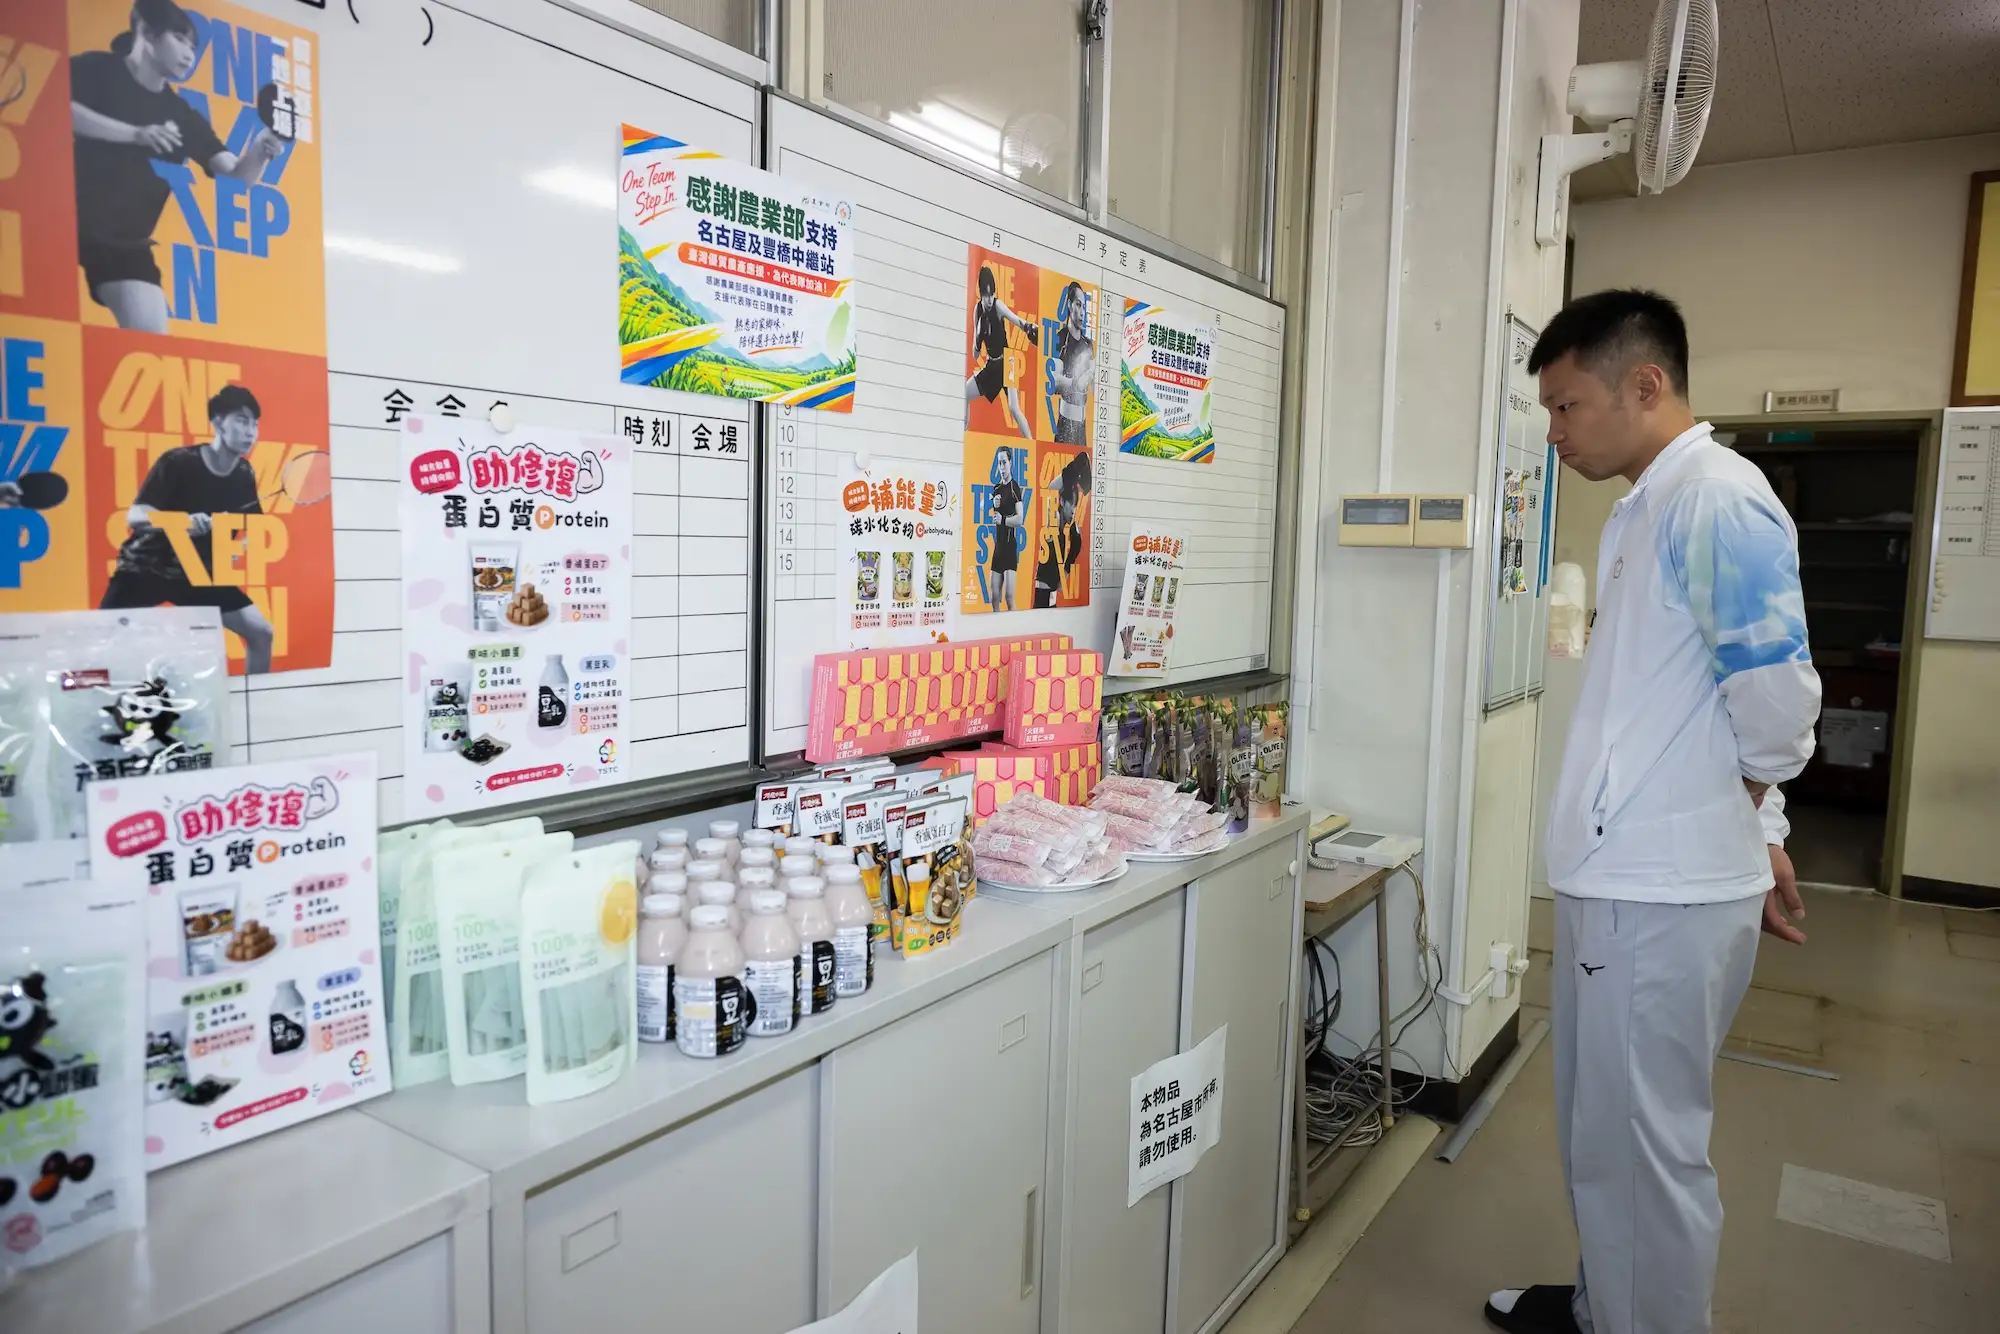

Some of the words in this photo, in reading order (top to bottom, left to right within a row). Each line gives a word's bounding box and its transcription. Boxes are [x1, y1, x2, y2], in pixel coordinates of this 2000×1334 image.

[622, 169, 645, 193] One
[647, 161, 677, 187] Team
[635, 189, 662, 218] Step
[697, 219, 835, 276] 名古屋及豐橋中繼站
[1103, 294, 1111, 308] 16
[1103, 313, 1110, 326] 17
[1102, 332, 1110, 346] 18
[1101, 351, 1109, 365] 19
[1100, 369, 1109, 385] 20
[1100, 389, 1108, 402] 21
[1099, 406, 1108, 421] 22
[692, 423, 738, 453] 会場
[781, 425, 795, 443] 10
[1098, 425, 1107, 439] 23
[1098, 444, 1106, 457] 24
[780, 451, 793, 468] 11
[471, 448, 578, 498] 助修復
[1097, 463, 1106, 476] 25
[780, 477, 794, 494] 12
[1097, 481, 1105, 495] 26
[870, 478, 936, 517] 補能量
[442, 495, 535, 531] 蛋白質
[780, 502, 794, 520] 13
[1096, 500, 1104, 513] 27
[850, 515, 915, 540] 碳水化合物
[1095, 518, 1104, 532] 28
[779, 528, 793, 545] 14
[1095, 536, 1104, 550] 29
[779, 554, 793, 571] 15
[1094, 554, 1103, 568] 30
[1093, 572, 1102, 586] 31
[145, 836, 256, 886] 蛋白質
[1140, 1079, 1180, 1113] 本物品
[1139, 1125, 1197, 1169] 請勿使用。
